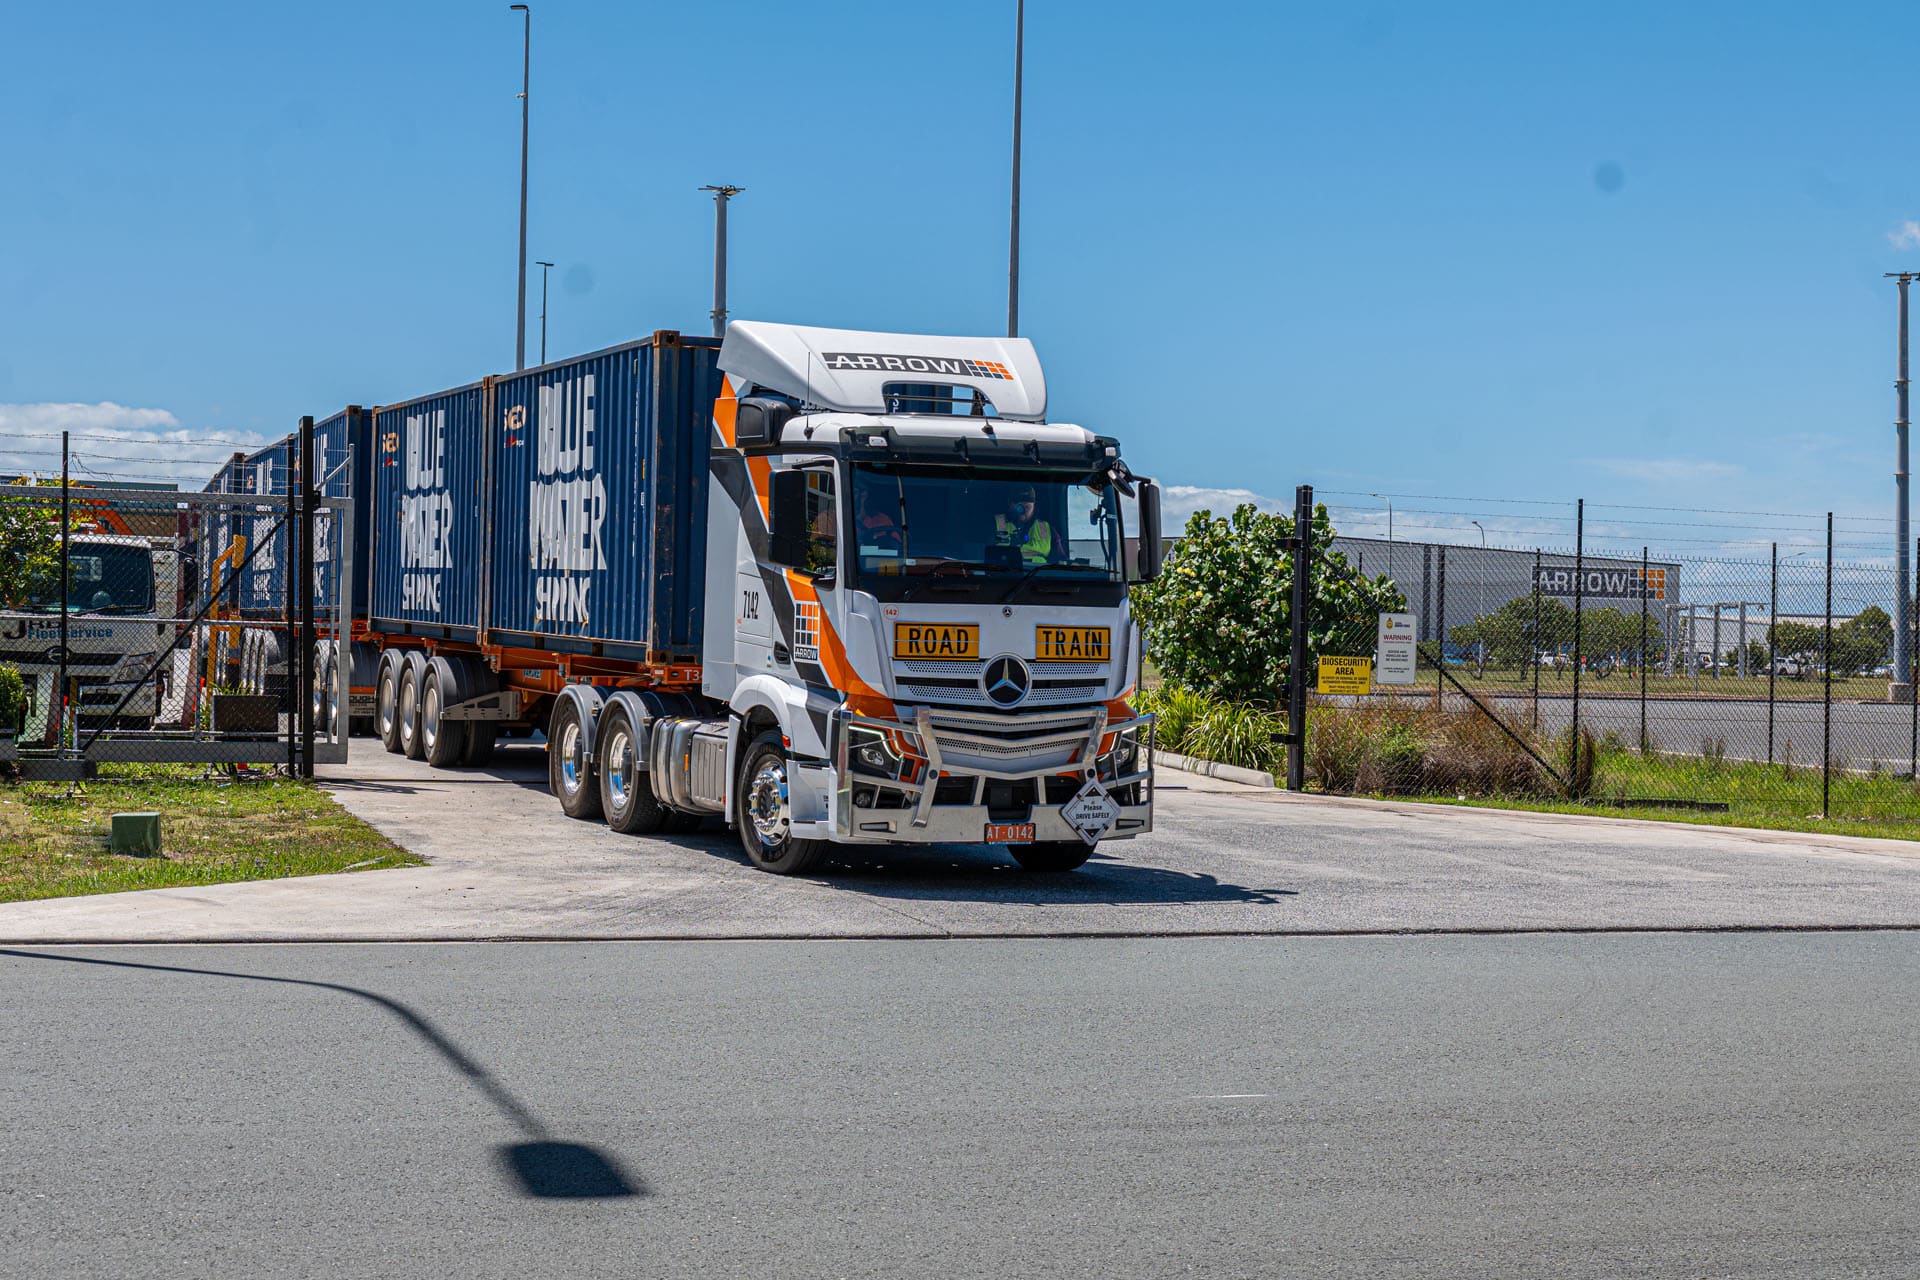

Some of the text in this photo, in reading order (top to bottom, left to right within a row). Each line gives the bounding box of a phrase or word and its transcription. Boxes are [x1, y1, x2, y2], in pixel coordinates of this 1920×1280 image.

[835, 355, 961, 374] ARROW
[538, 374, 595, 477] BLUE
[406, 409, 445, 491] BLUE
[401, 489, 453, 568] WATER
[529, 473, 607, 570] WATER
[1539, 570, 1627, 593] ARROW
[743, 590, 759, 620] 7142
[885, 608, 898, 617] 142
[908, 627, 1103, 657] ROAD TRAIN
[1383, 633, 1413, 641] WARNING
[795, 646, 819, 661] ARROW
[1321, 657, 1369, 667] BIOSECURITY
[1335, 667, 1355, 676] AREA
[1083, 804, 1103, 812] Please
